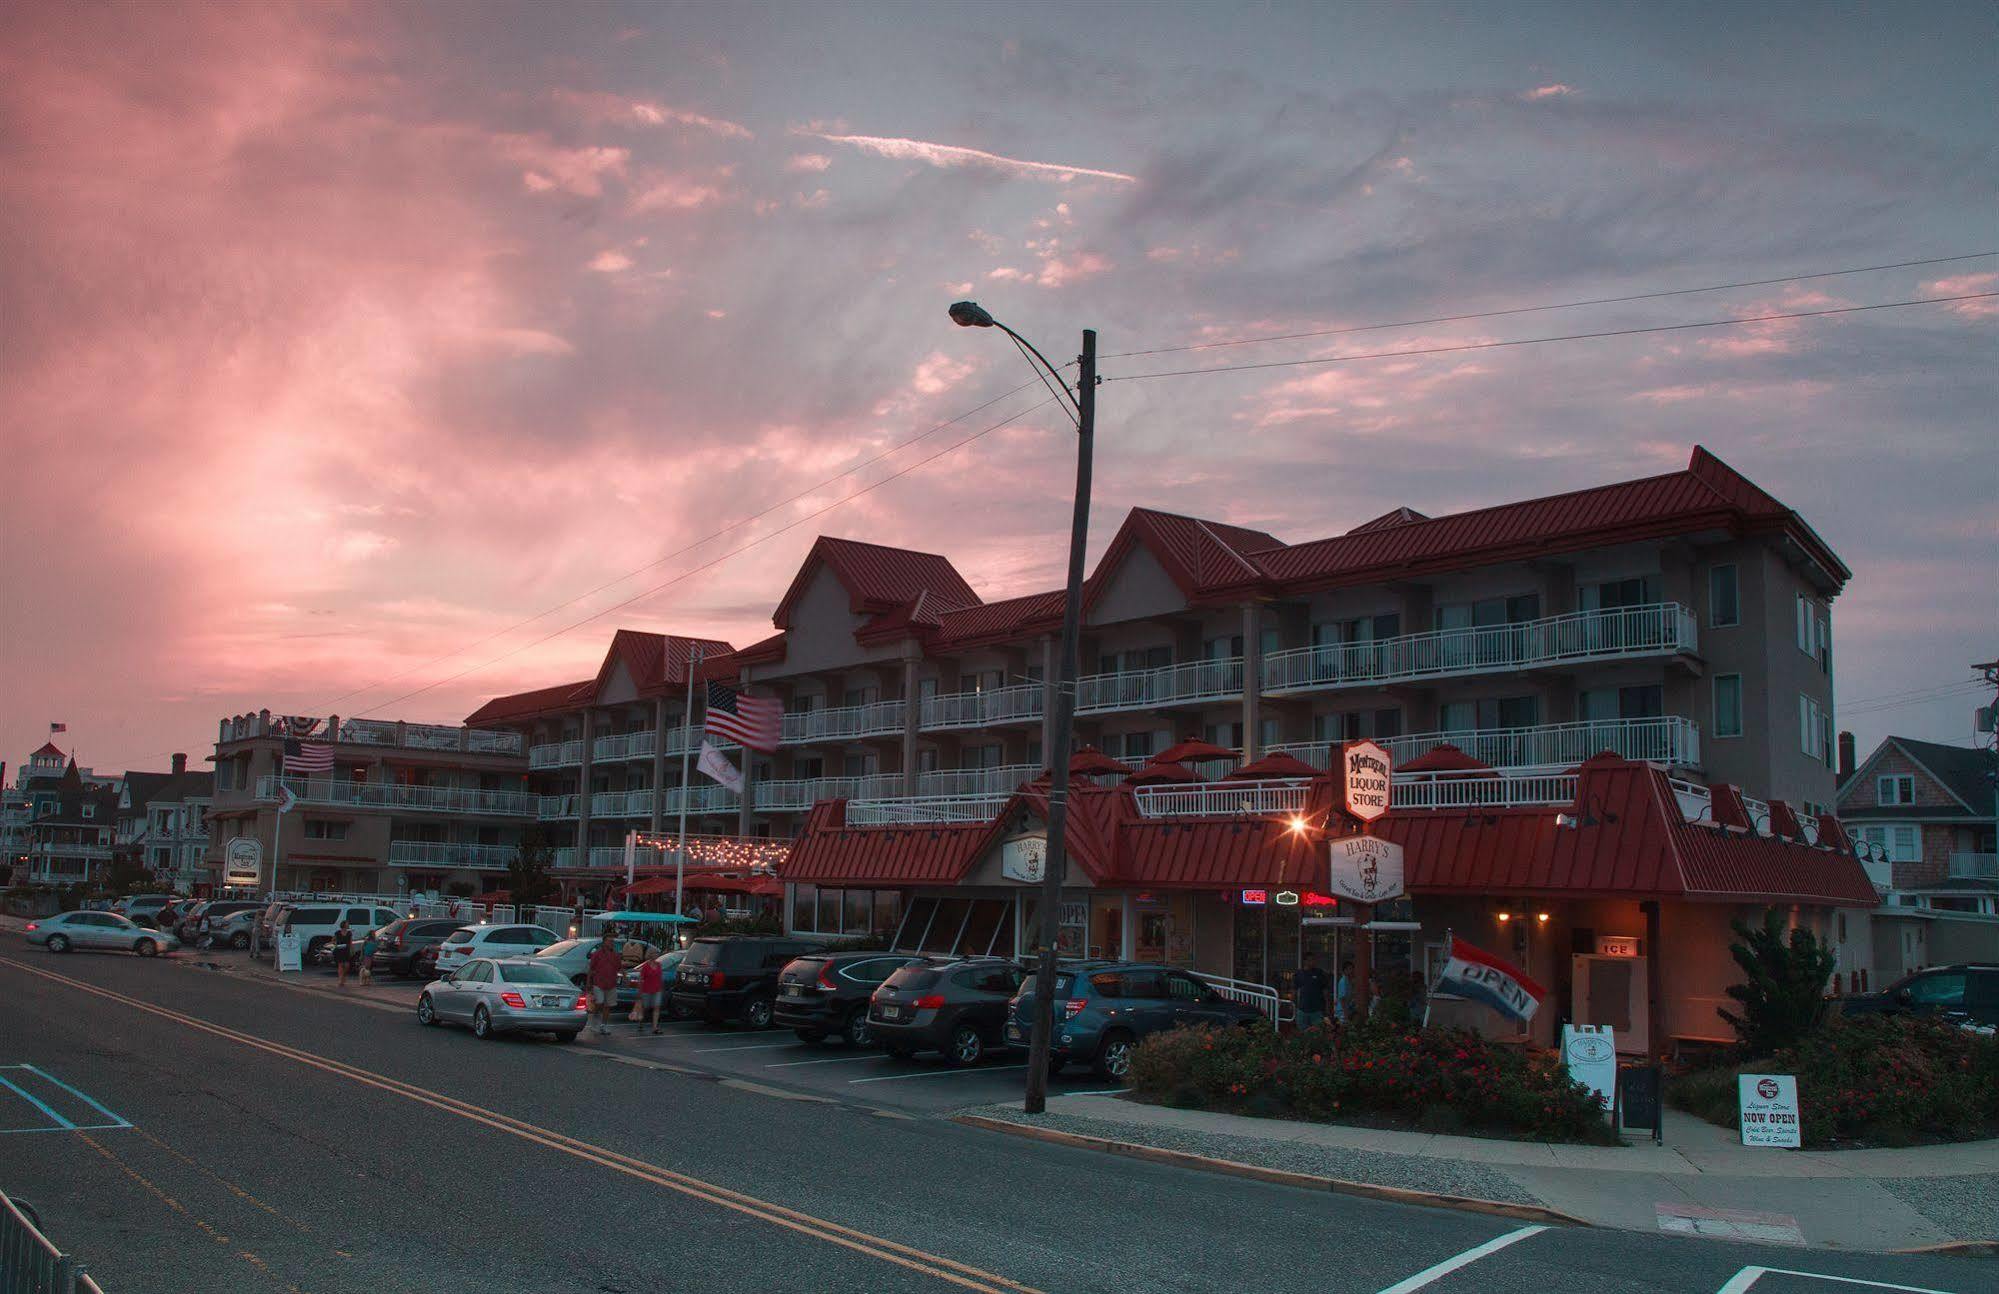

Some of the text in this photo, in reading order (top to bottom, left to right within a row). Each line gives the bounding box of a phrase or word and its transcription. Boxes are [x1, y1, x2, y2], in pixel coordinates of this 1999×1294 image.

[1350, 777, 1386, 791] LIQUOR
[1353, 793, 1384, 807] STORE
[1346, 839, 1390, 858] HARRY'S
[1245, 892, 1266, 902] OPEN
[1059, 904, 1088, 924] OPEN
[1604, 945, 1628, 954] ICE
[1463, 967, 1530, 1012] OPEN
[1746, 1102, 1769, 1111] Liquor
[1744, 1112, 1796, 1125] NOW OPEN
